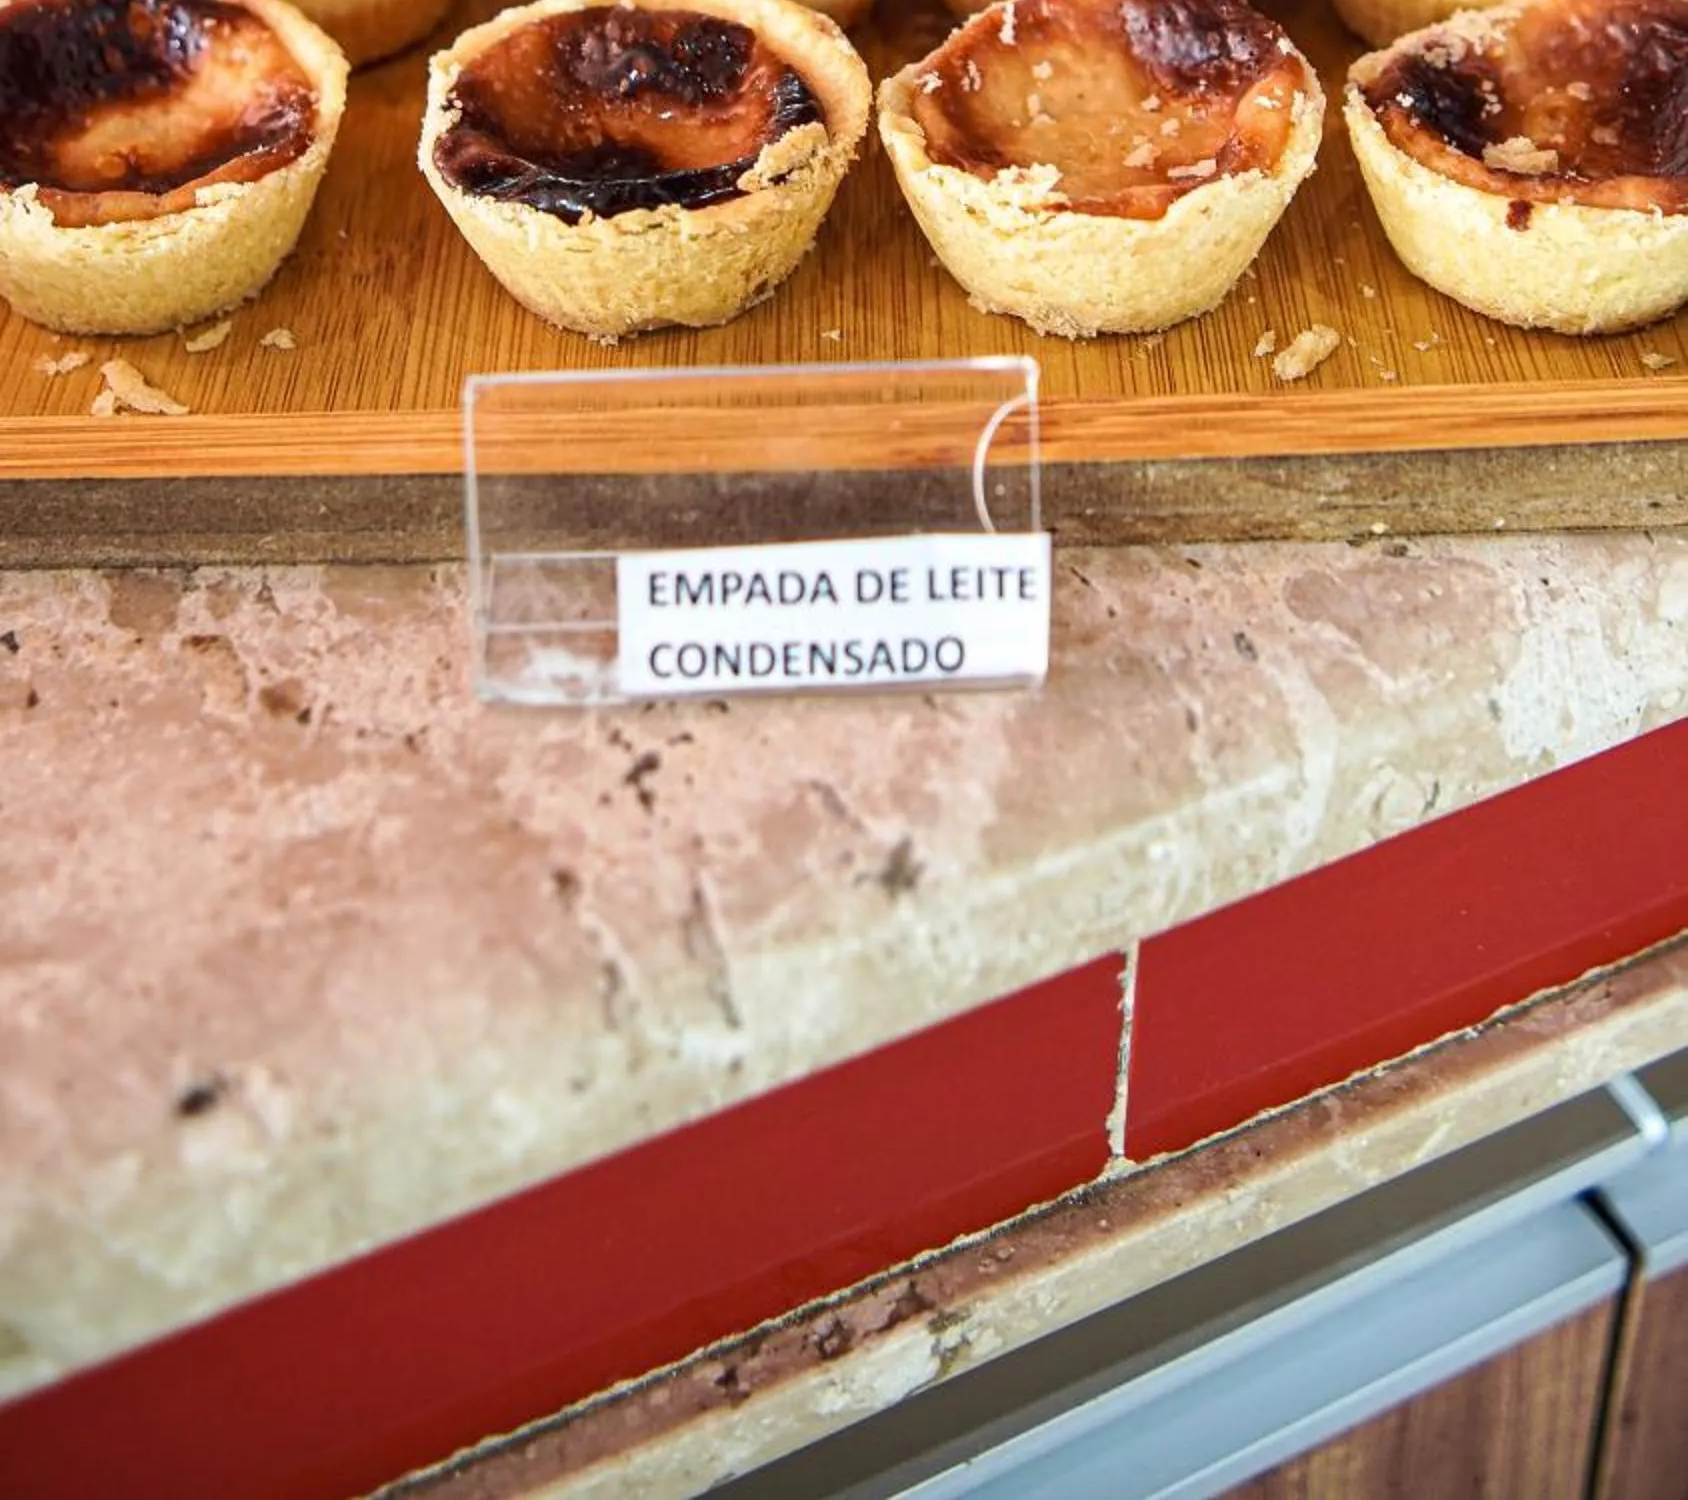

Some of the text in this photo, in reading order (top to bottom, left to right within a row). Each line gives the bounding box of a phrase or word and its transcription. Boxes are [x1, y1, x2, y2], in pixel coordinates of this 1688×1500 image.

[648, 564, 1038, 606] EMPADA DE LEITE
[648, 636, 965, 677] CONDENSADO
